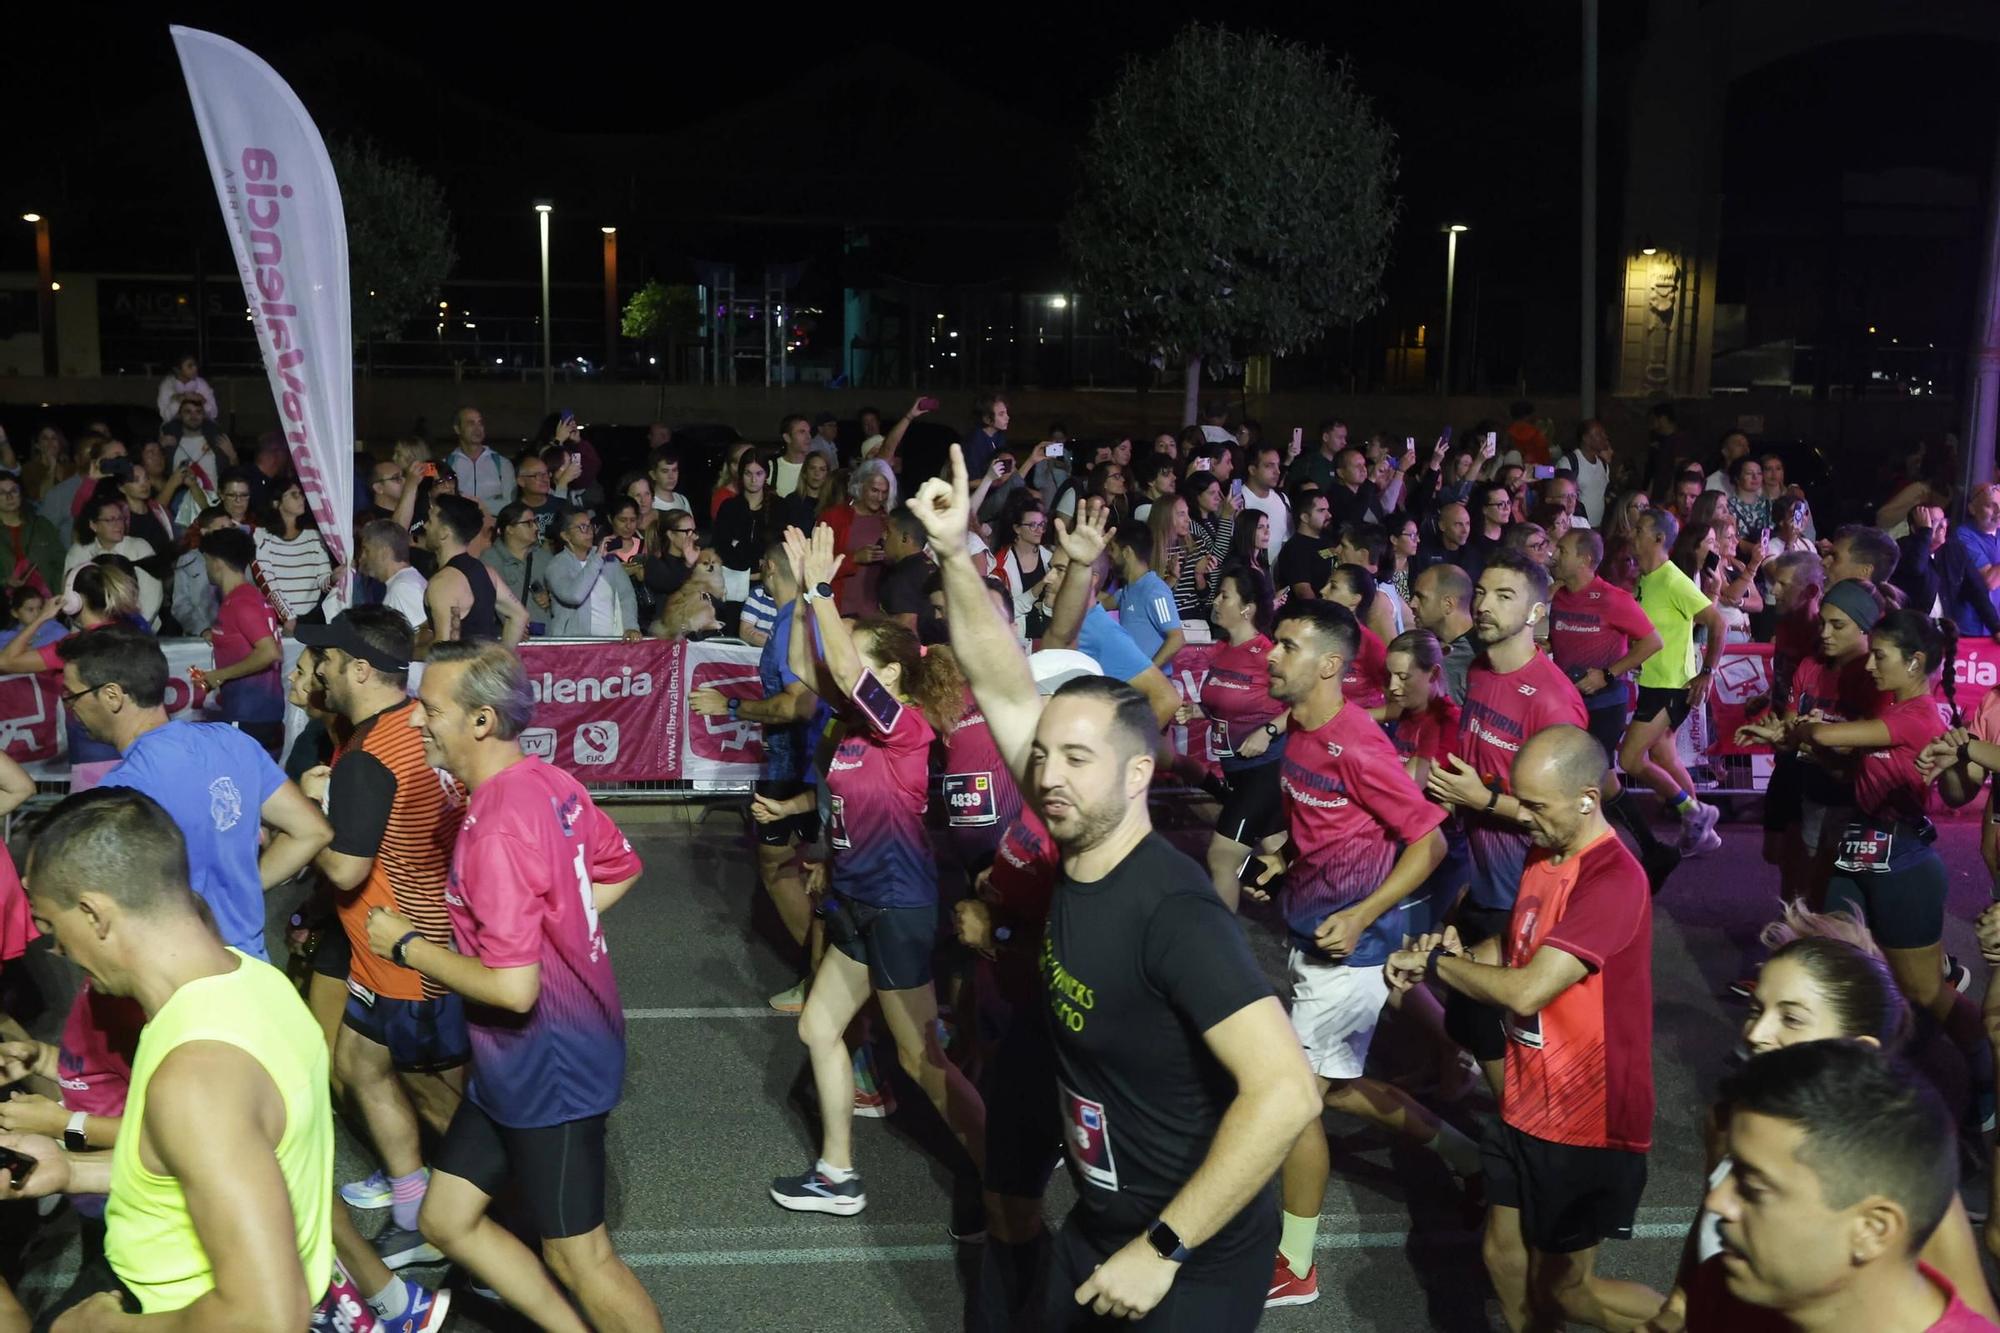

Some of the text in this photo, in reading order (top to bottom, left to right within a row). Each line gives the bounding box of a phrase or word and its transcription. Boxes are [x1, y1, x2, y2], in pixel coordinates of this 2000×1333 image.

[667, 644, 681, 772] www.fibravalencia.es
[526, 739, 543, 750] TV
[586, 754, 605, 763] FIJO
[950, 792, 982, 808] 4839
[1845, 840, 1878, 855] 7755
